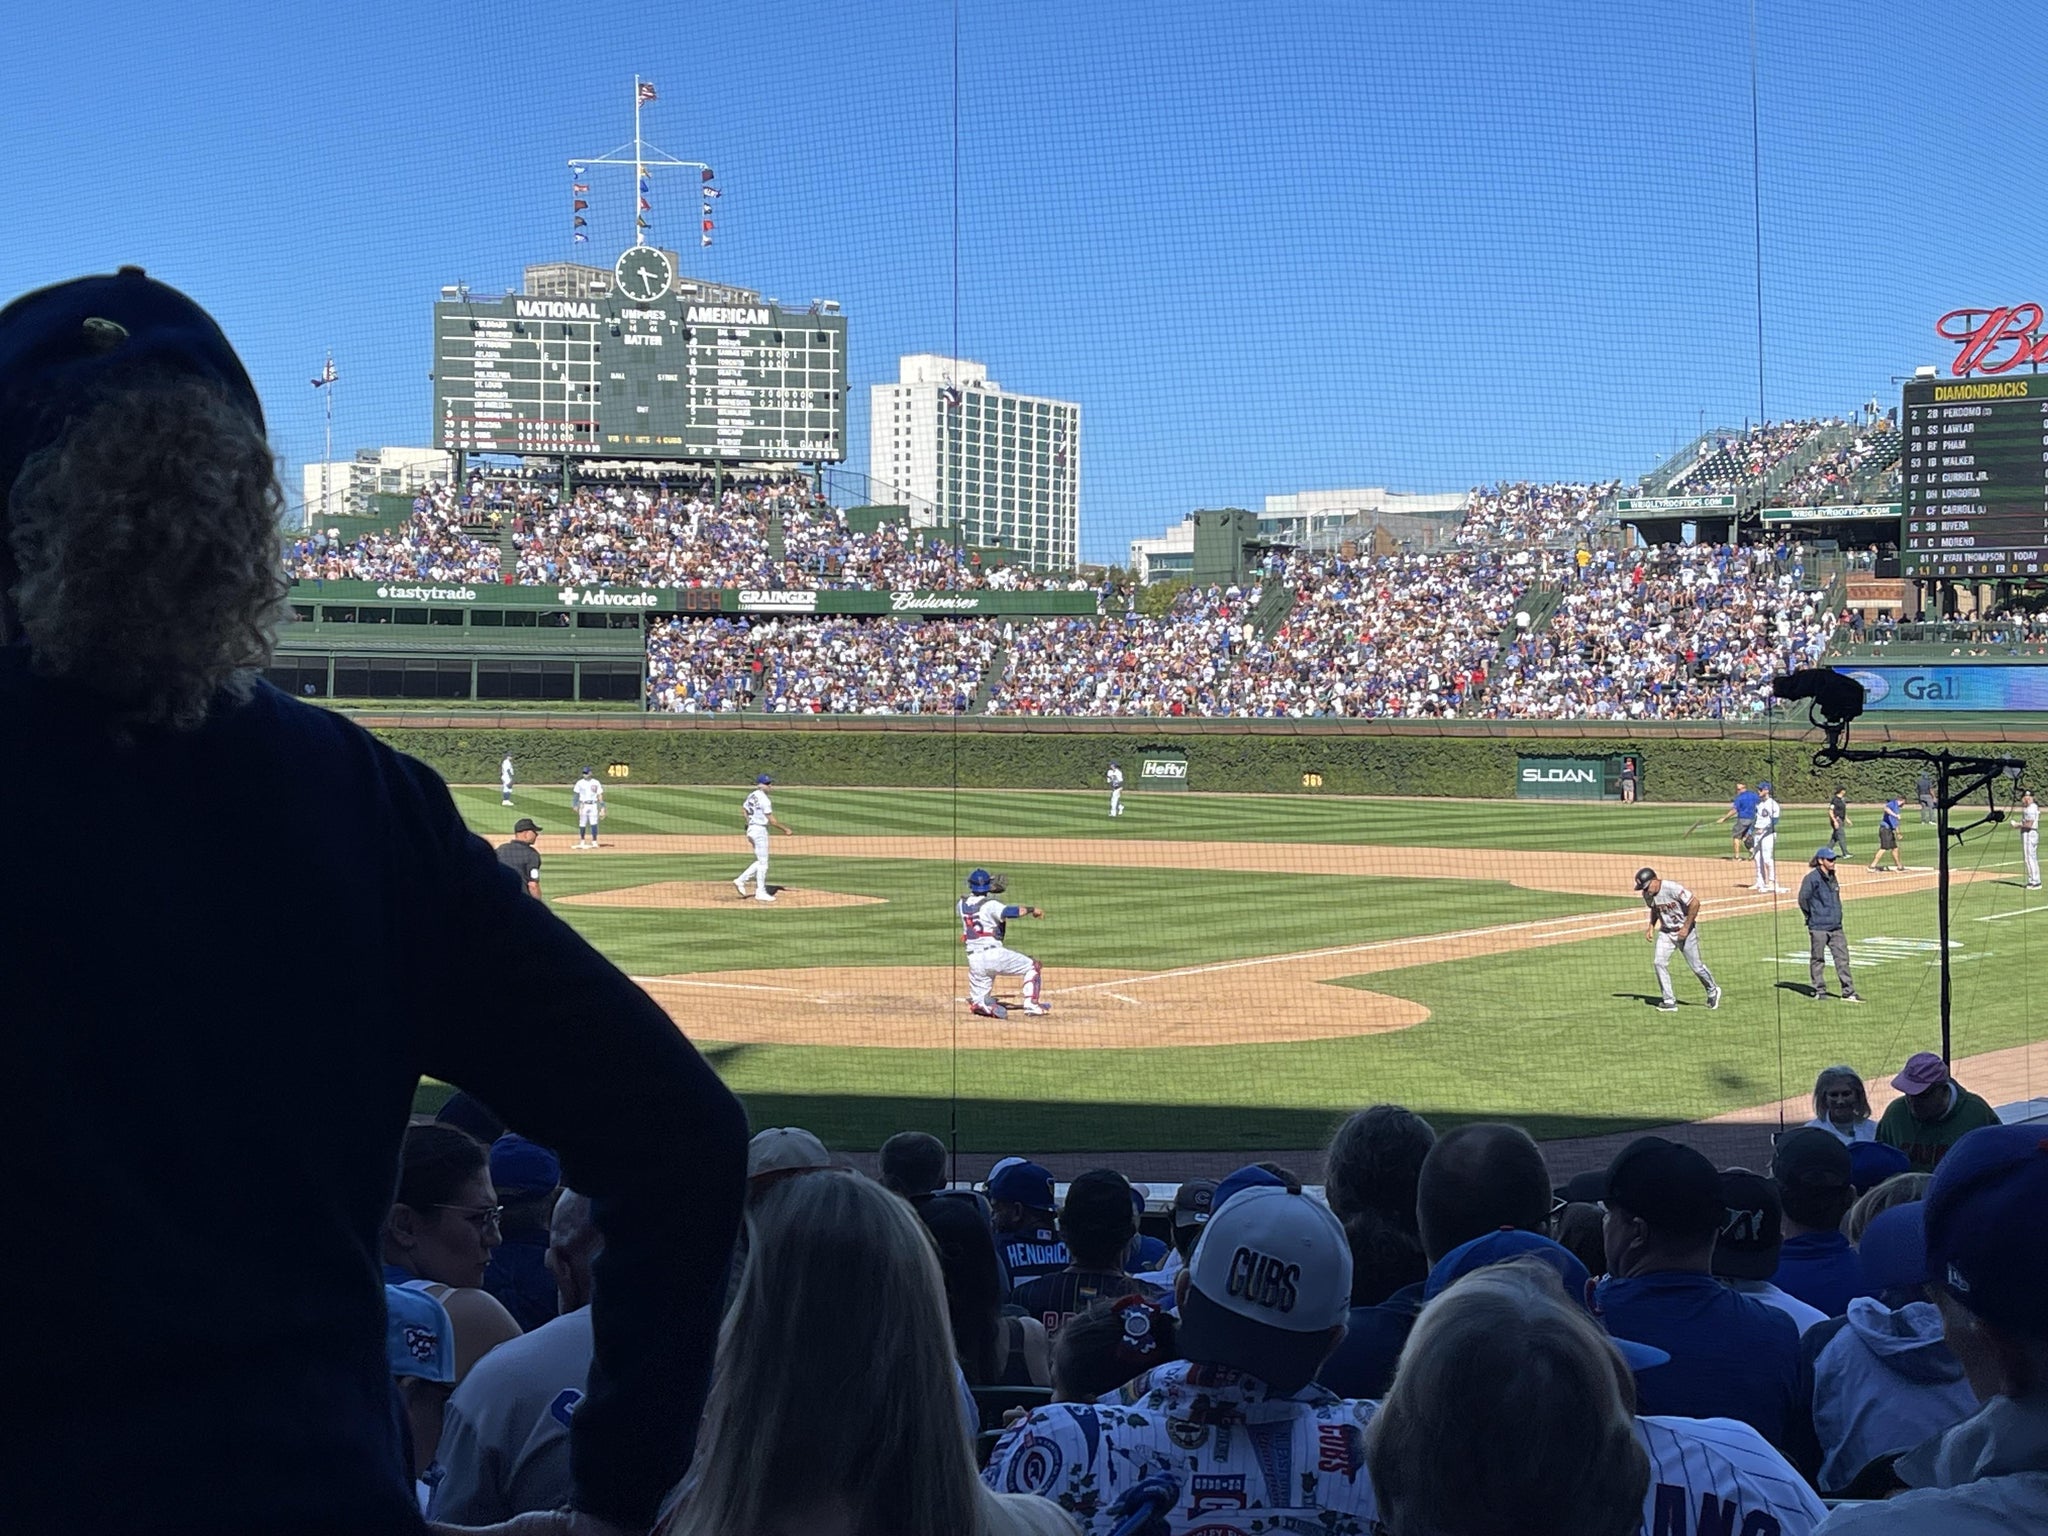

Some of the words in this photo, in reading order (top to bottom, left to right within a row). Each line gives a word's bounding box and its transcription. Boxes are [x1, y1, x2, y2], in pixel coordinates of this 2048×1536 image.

[516, 300, 600, 319] NATIONAL
[622, 309, 666, 320] UMPIRES
[686, 306, 769, 325] AMERICAN
[624, 334, 662, 345] BATTER
[1935, 381, 2028, 401] DIAMONDBACKS
[1911, 410, 1917, 420] 2
[1927, 425, 1938, 435] SS
[1943, 423, 1974, 434] LAWLAR
[1942, 440, 1966, 450] PHAM
[1910, 458, 1921, 468] 53
[1942, 456, 1974, 466] WALKER
[1910, 474, 1919, 484] 12
[1927, 474, 1937, 483] LF
[1910, 490, 1916, 500] 3
[1942, 488, 1980, 499] LONGORIA
[1910, 506, 1916, 515] 7
[1926, 506, 1937, 515] CF
[1910, 522, 1918, 532] 15
[1941, 521, 1970, 531] RIVERA
[1909, 539, 1918, 548] 14
[1928, 538, 1934, 547] C
[1941, 536, 1974, 547] MORENO
[1933, 554, 1938, 562] P
[1964, 552, 2005, 562] THOMPSON
[2014, 551, 2038, 560] TODAY
[388, 586, 476, 602] tastytrade
[582, 589, 657, 606] Advocate
[738, 590, 817, 604] GRAINGER
[890, 592, 979, 610] Budweiser
[607, 764, 629, 778] 400
[1144, 762, 1185, 777] Hefty
[1226, 1246, 1300, 1313] CUBS
